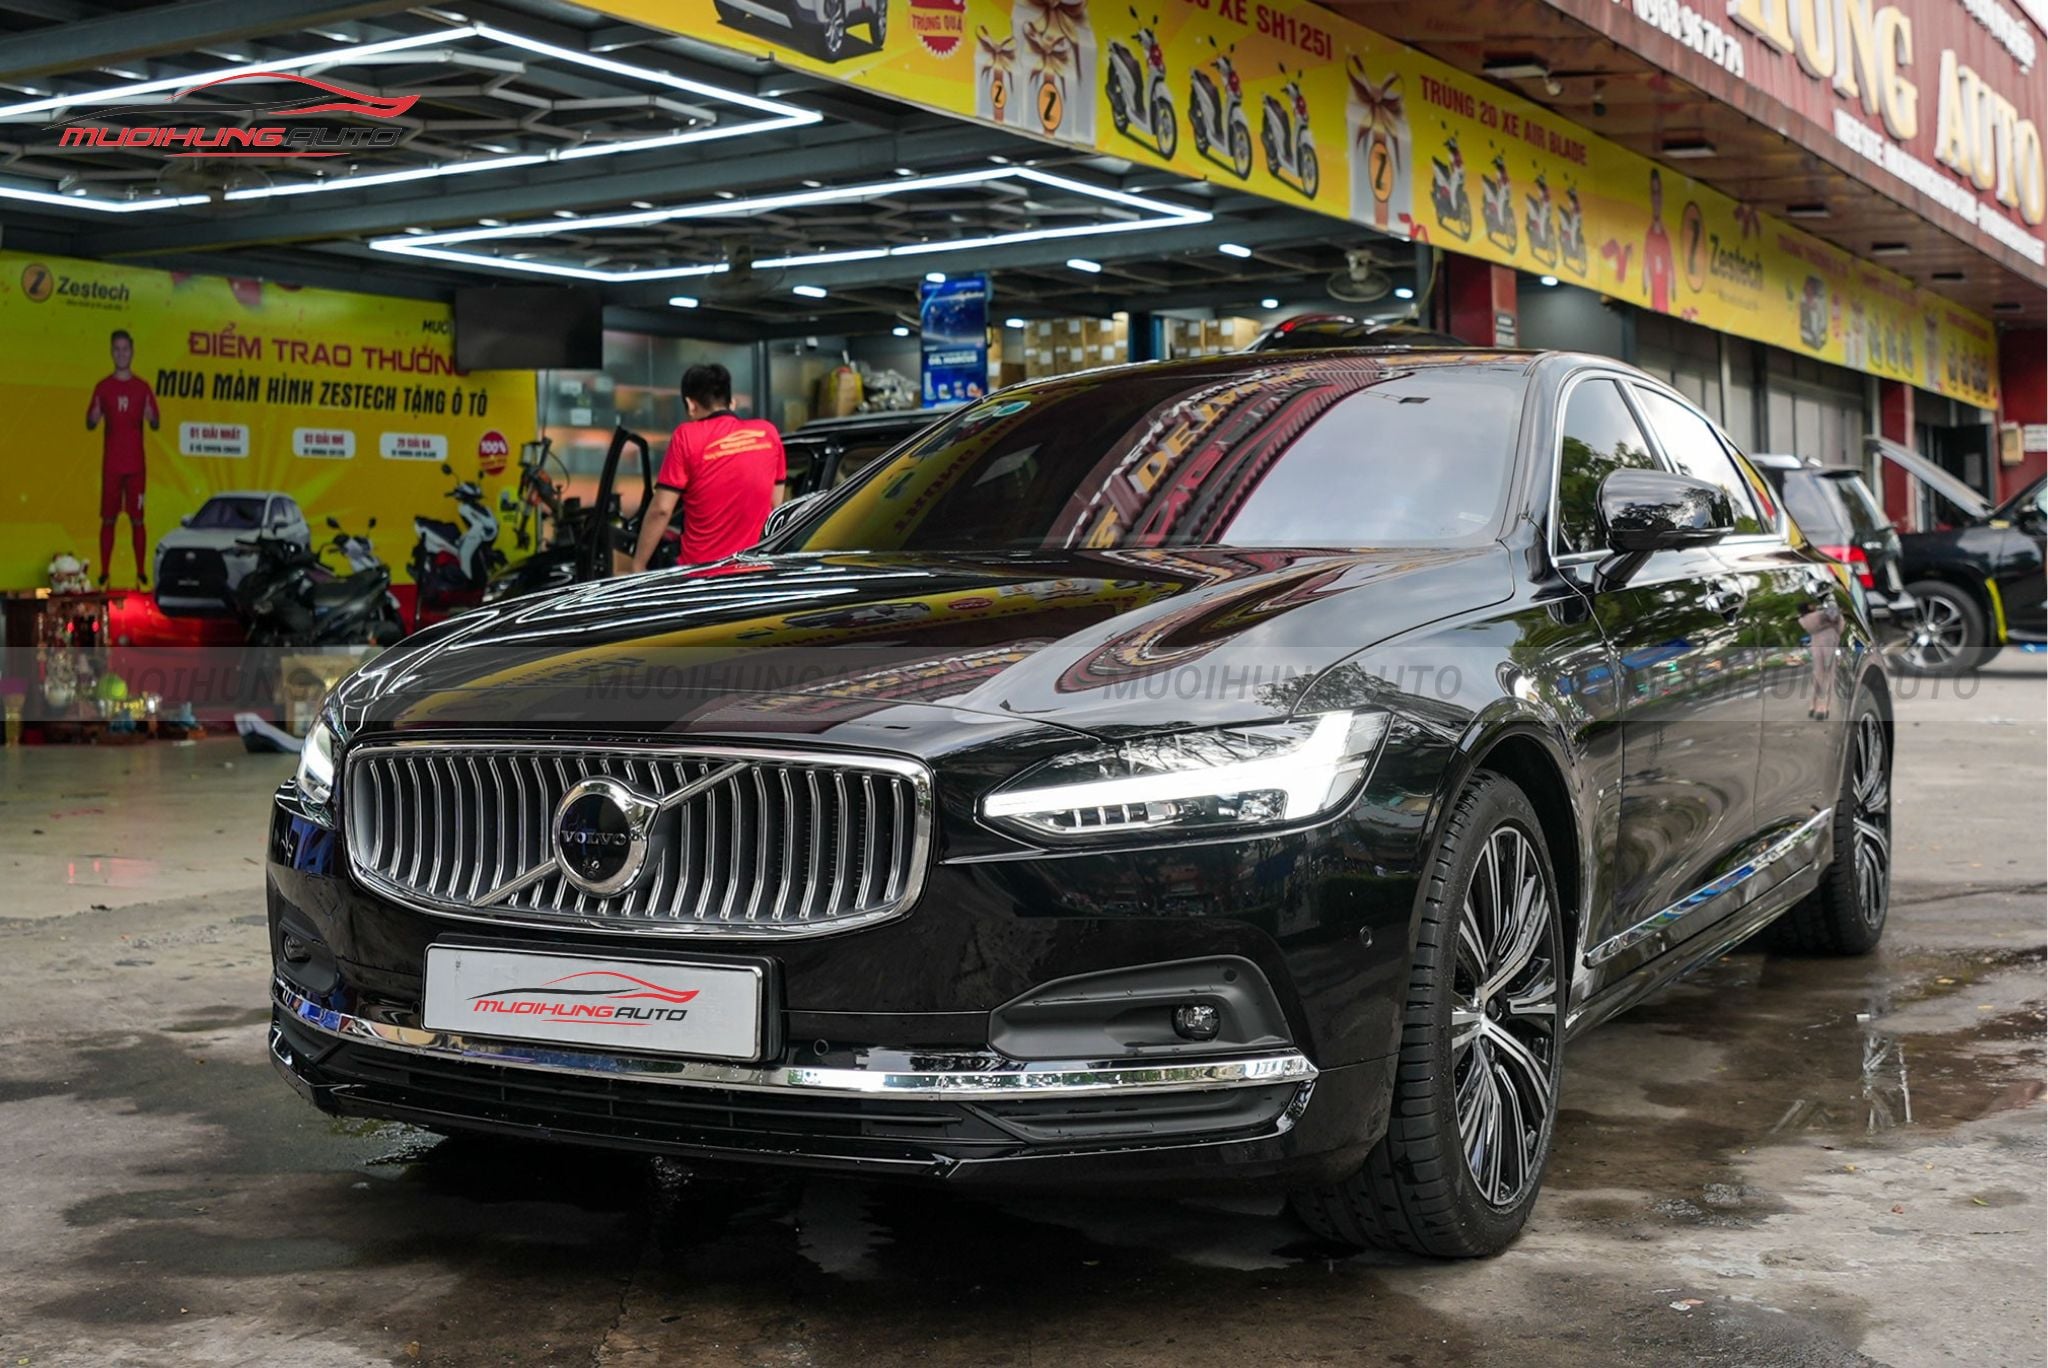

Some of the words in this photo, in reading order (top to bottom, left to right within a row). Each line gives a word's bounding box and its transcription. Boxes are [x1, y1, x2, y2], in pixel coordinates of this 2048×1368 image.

[1256, 4, 1333, 61] SH125I
[1479, 101, 1499, 129] 20
[1501, 109, 1520, 138] XE
[1523, 120, 1548, 150] AIR
[1549, 135, 1589, 167] BLADE
[1933, 48, 2044, 226] AUTO
[56, 275, 131, 302] Zestech
[188, 322, 262, 361] ĐIỂM
[271, 338, 352, 369] TRAO
[155, 369, 205, 399] MUA
[212, 368, 261, 403] MÀN
[266, 373, 314, 406] HÌNH
[318, 381, 398, 412] ZESTECH
[403, 384, 447, 419] TẶNG
[451, 386, 464, 416] Ô
[468, 388, 489, 418] TÔ
[561, 829, 627, 847] VOLVO
[472, 999, 688, 1022] MUOIHUNGAUTO
